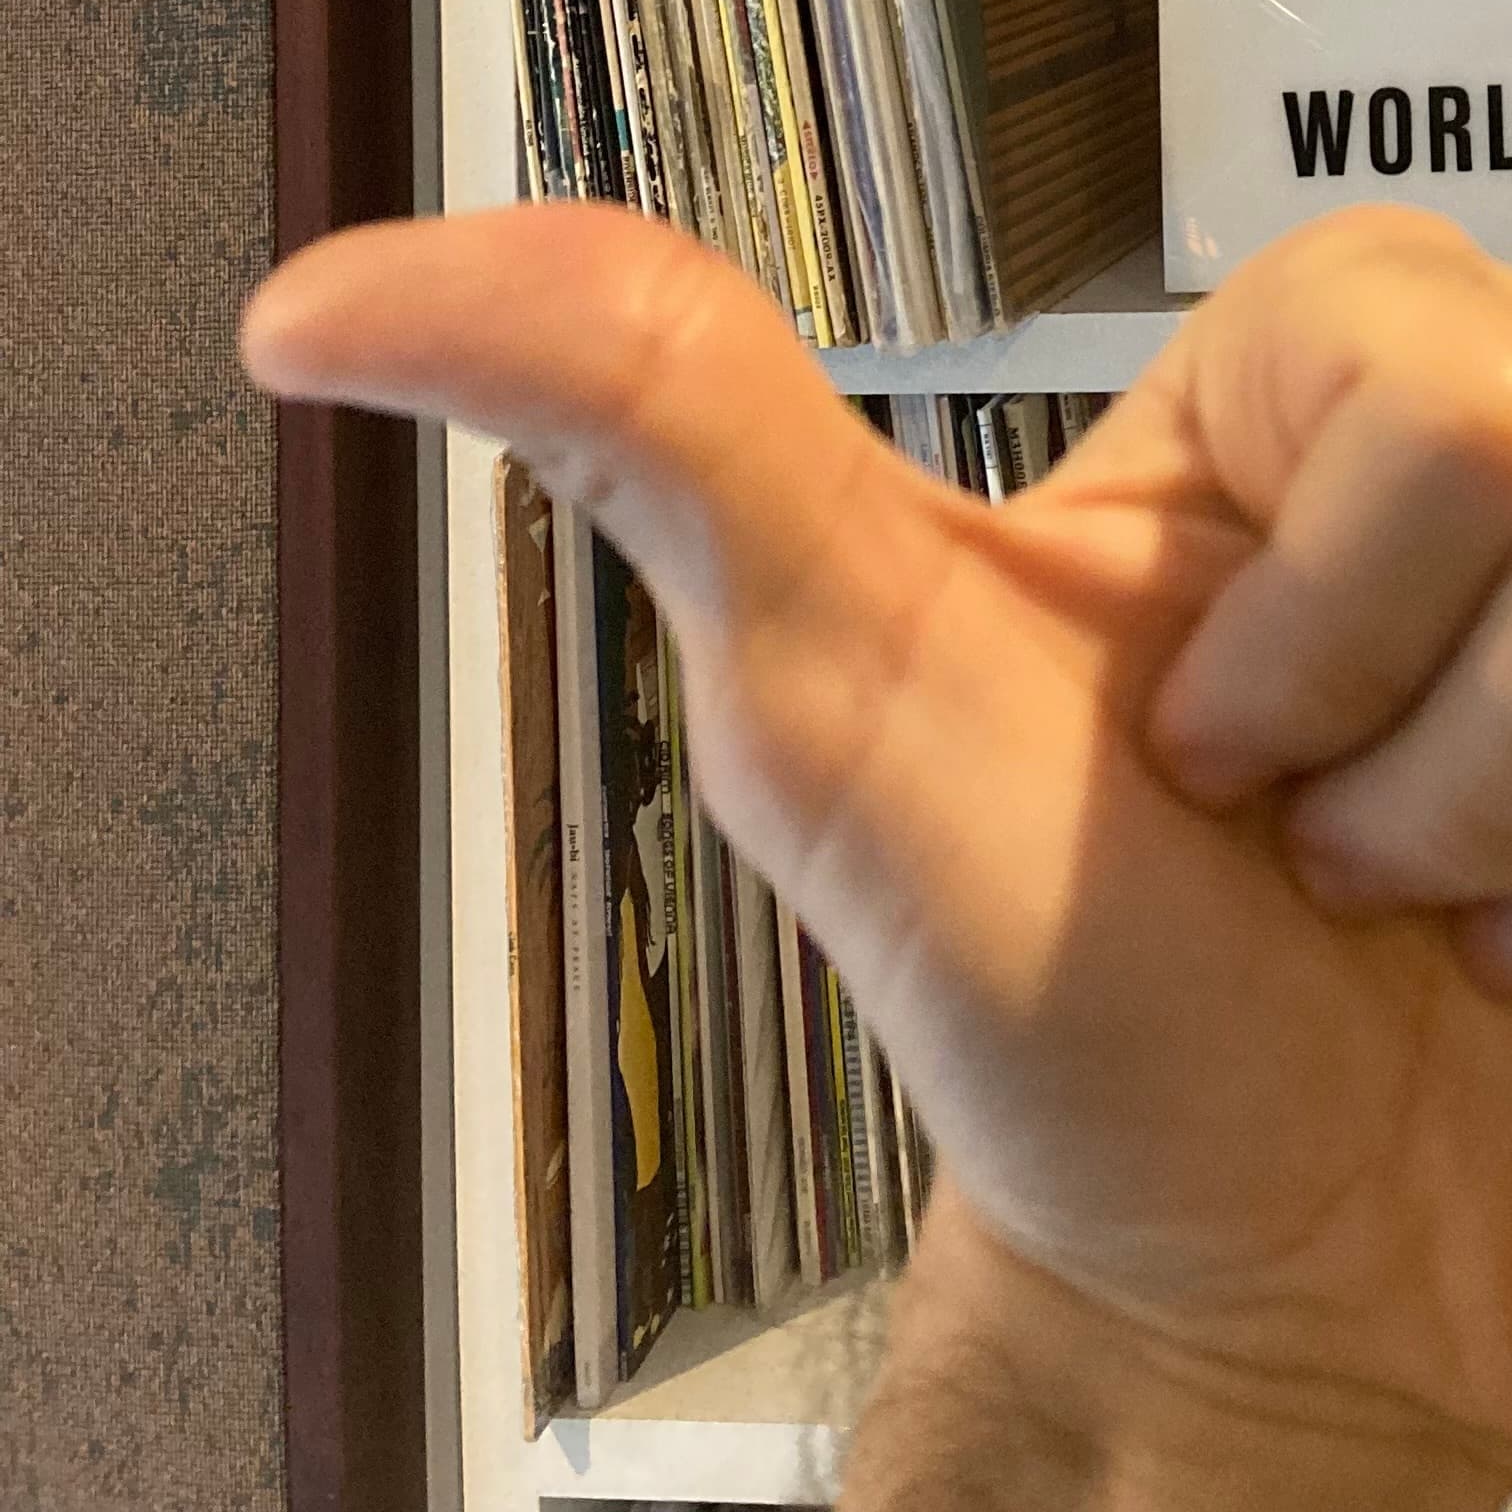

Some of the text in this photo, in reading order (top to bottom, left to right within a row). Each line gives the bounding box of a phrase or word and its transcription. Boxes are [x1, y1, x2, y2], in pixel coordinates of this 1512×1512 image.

[803, 129, 818, 170] STEREO
[662, 858, 676, 879] OF
[570, 946, 581, 993] PEACE
